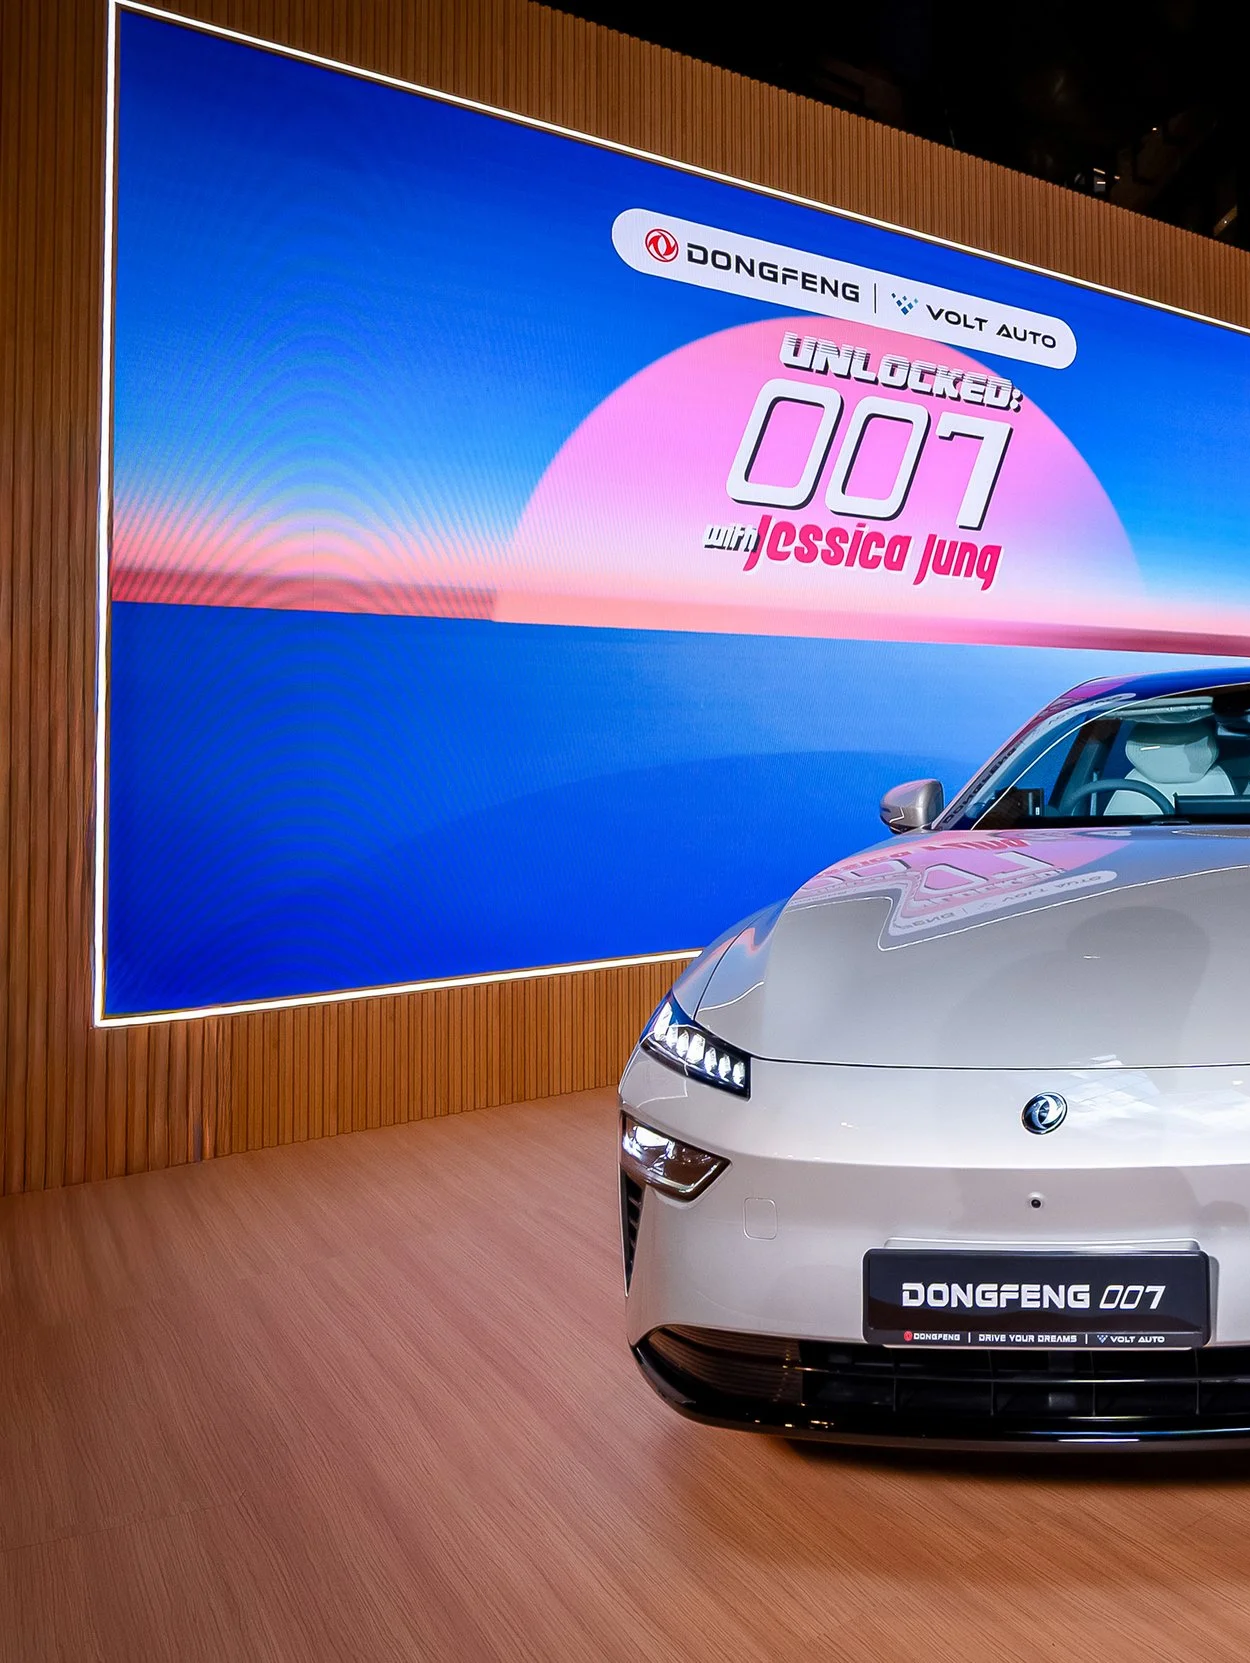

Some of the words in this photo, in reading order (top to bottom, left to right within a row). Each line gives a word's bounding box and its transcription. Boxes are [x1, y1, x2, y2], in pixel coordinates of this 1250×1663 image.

[687, 243, 860, 303] DONGFENG
[926, 304, 988, 332] VOLT
[996, 323, 1057, 349] AUTO
[778, 331, 1024, 412] UNLOCKED:
[726, 378, 1014, 532] 007
[742, 514, 914, 573] Jessica
[913, 533, 1004, 592] Jung
[902, 1282, 1090, 1309] DONGFENG
[1099, 1284, 1167, 1310] 007
[913, 1332, 961, 1341] DONGFENG
[978, 1334, 1007, 1342] DRIVE
[1008, 1334, 1036, 1343] YOUR
[1037, 1335, 1078, 1343] DREAMS
[1109, 1335, 1136, 1343] VOLT
[1137, 1335, 1166, 1344] AUTO
